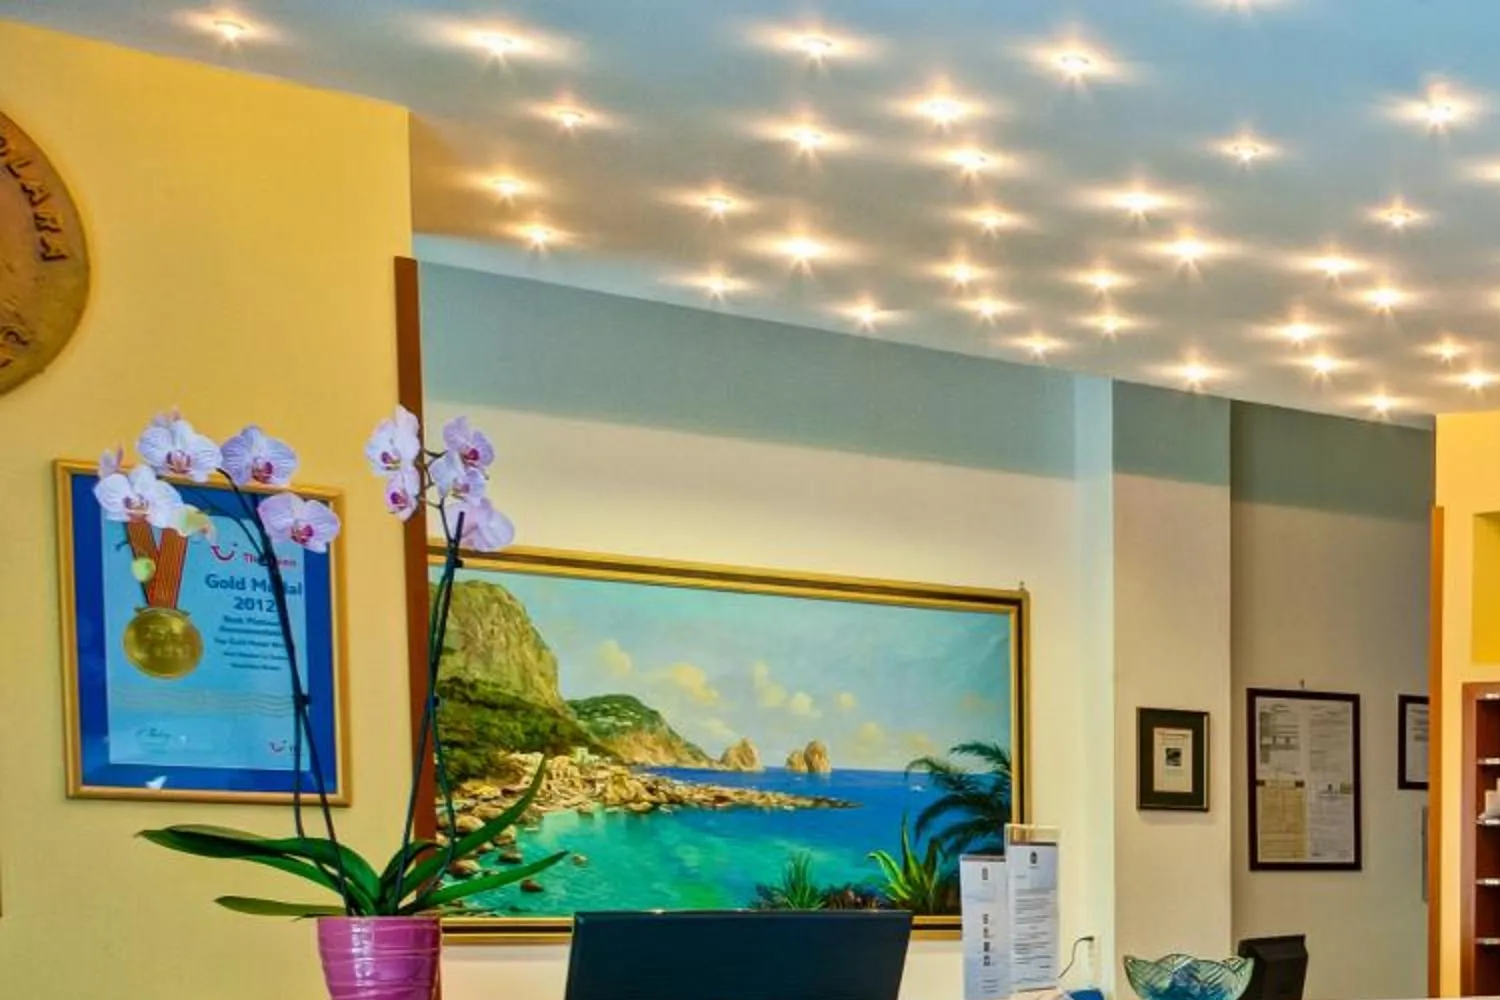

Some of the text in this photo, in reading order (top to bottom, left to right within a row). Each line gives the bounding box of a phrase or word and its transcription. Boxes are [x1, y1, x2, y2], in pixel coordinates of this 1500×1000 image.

[205, 573, 303, 595] Gold Mal
[233, 595, 278, 613] 2012
